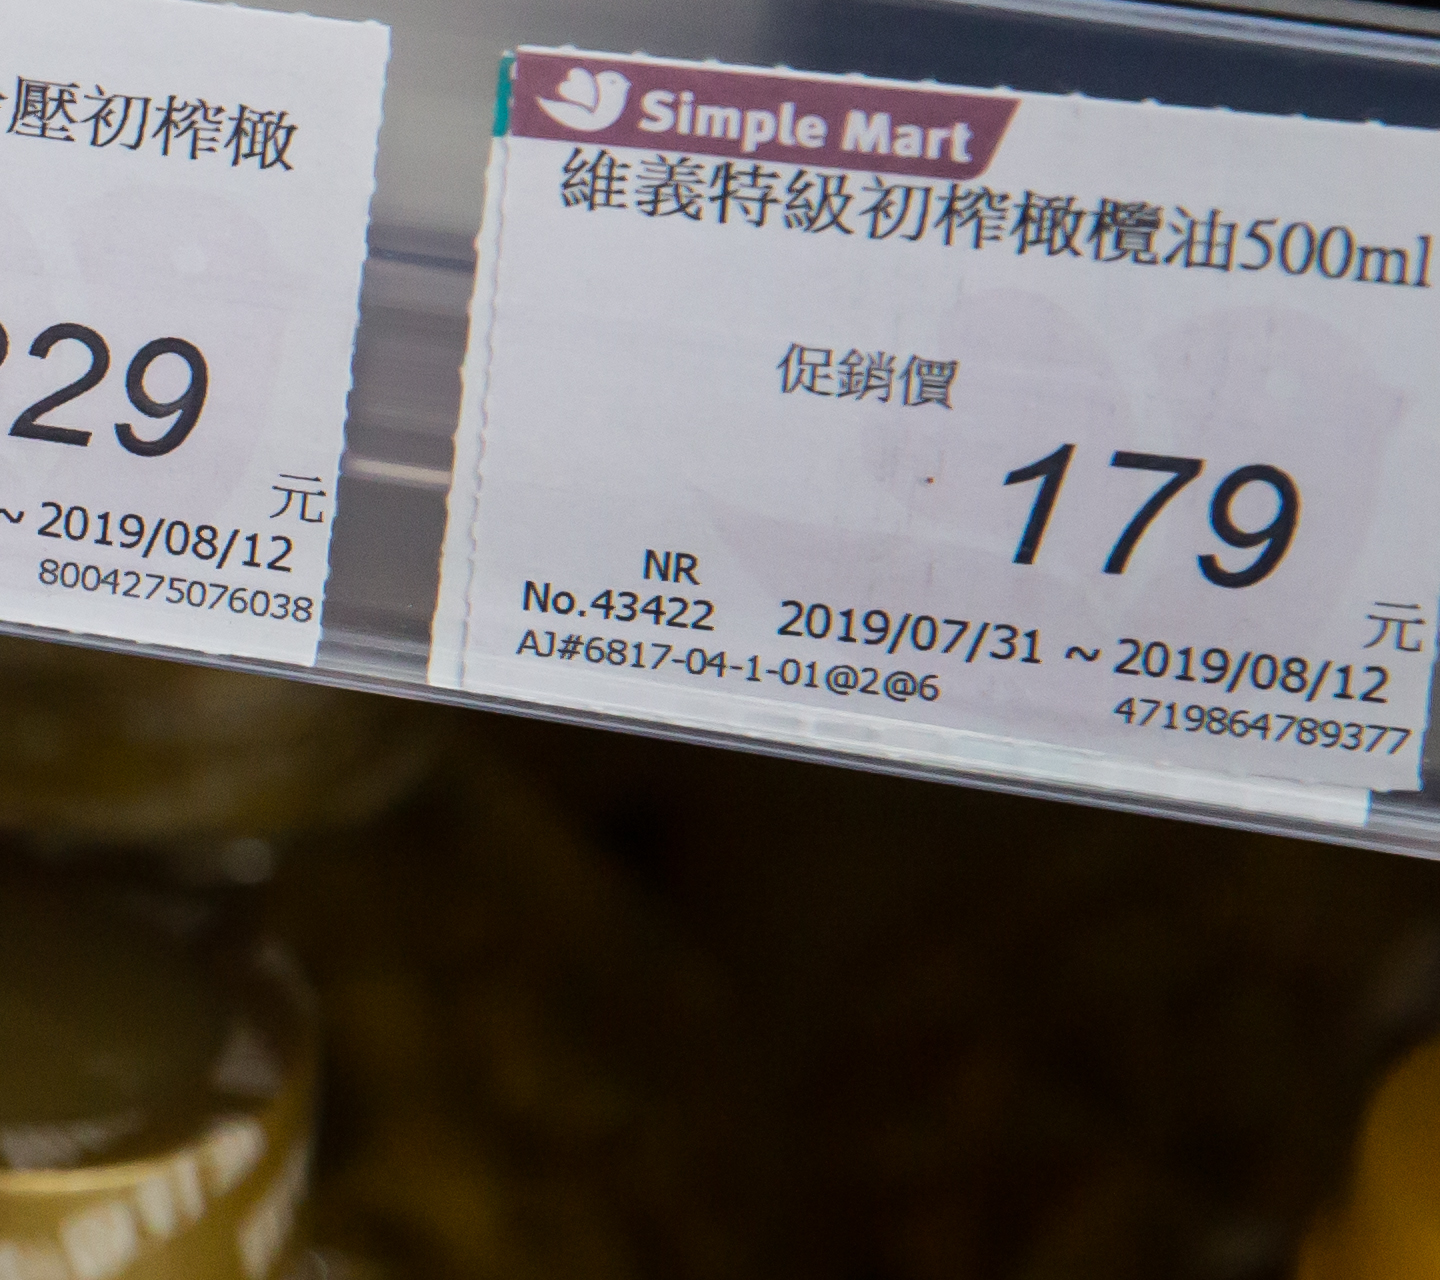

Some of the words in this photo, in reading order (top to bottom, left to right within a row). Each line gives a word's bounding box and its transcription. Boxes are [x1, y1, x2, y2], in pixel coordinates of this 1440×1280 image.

[637, 89, 829, 154] Simple
[842, 109, 974, 164] Mart
[776, 342, 961, 410] 促銷價
[270, 473, 327, 524] 元
[1003, 442, 1303, 589] 179
[36, 501, 294, 573] 2019/08/12
[642, 549, 700, 586] NR
[37, 558, 314, 623] 8004275076038
[521, 580, 716, 632] No.43422
[776, 599, 1043, 664] 2019/07/31
[1112, 638, 1391, 705] 2019/08/12
[1362, 601, 1427, 653] 元
[515, 629, 942, 703] AJ#6817-04-1-01@2@6
[1112, 696, 1413, 756] 4719864789377
